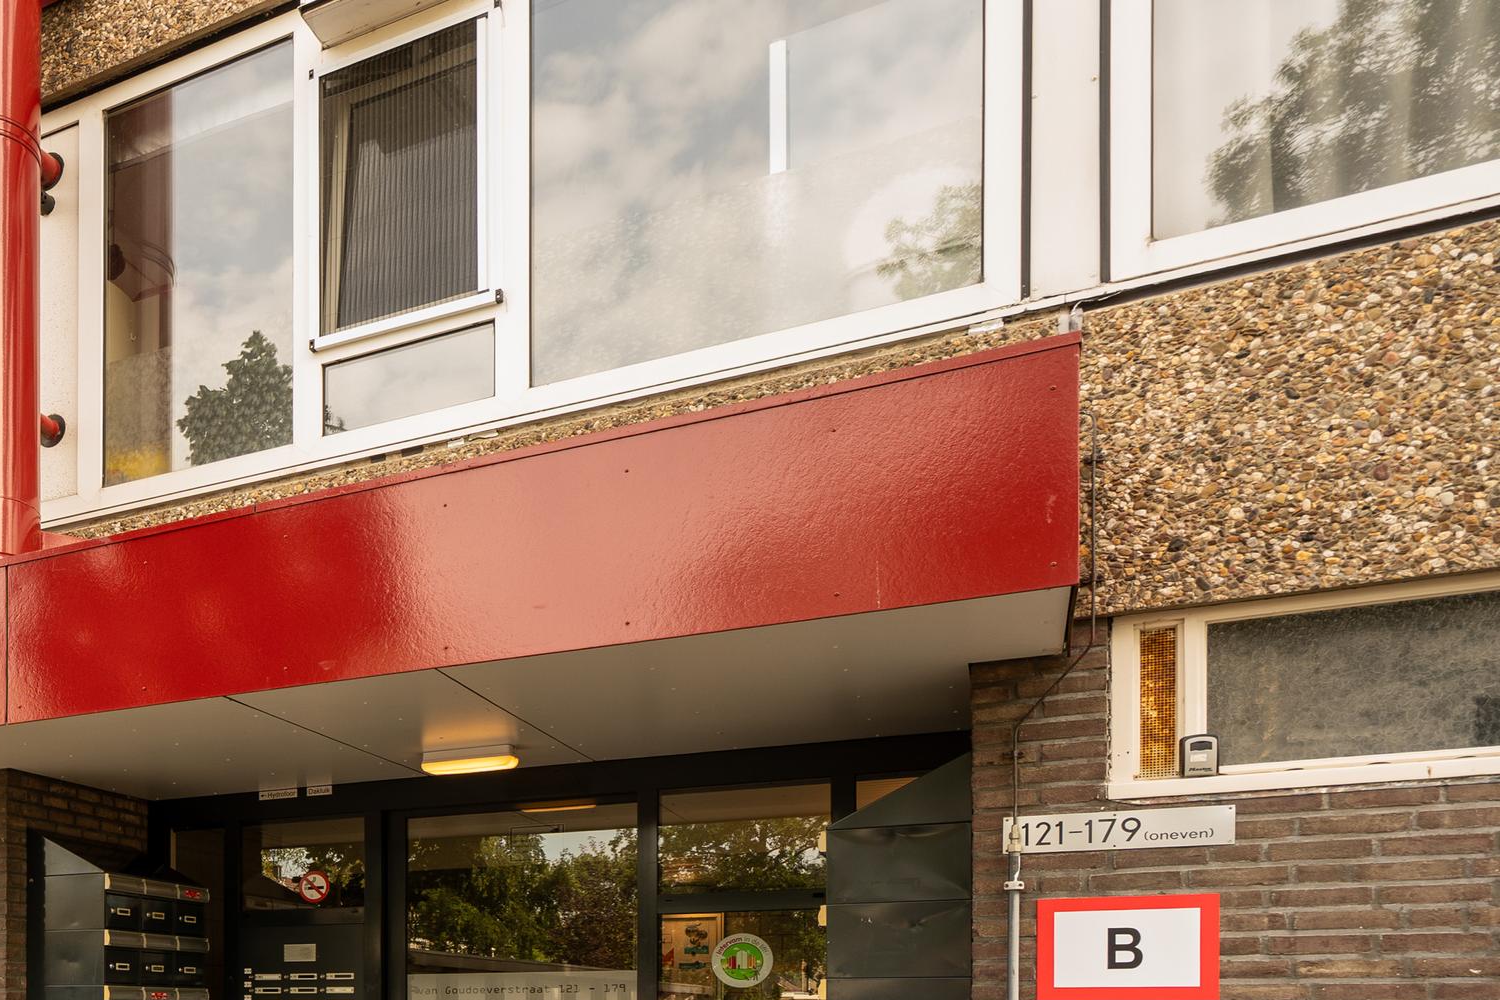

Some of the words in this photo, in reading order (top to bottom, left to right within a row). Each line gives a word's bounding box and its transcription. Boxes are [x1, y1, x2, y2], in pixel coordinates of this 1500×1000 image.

[1021, 817, 1141, 847] 121-179
[1144, 828, 1214, 842] (oneven)
[1108, 928, 1143, 970] B
[558, 983, 580, 993] 121
[603, 983, 626, 993] 179
